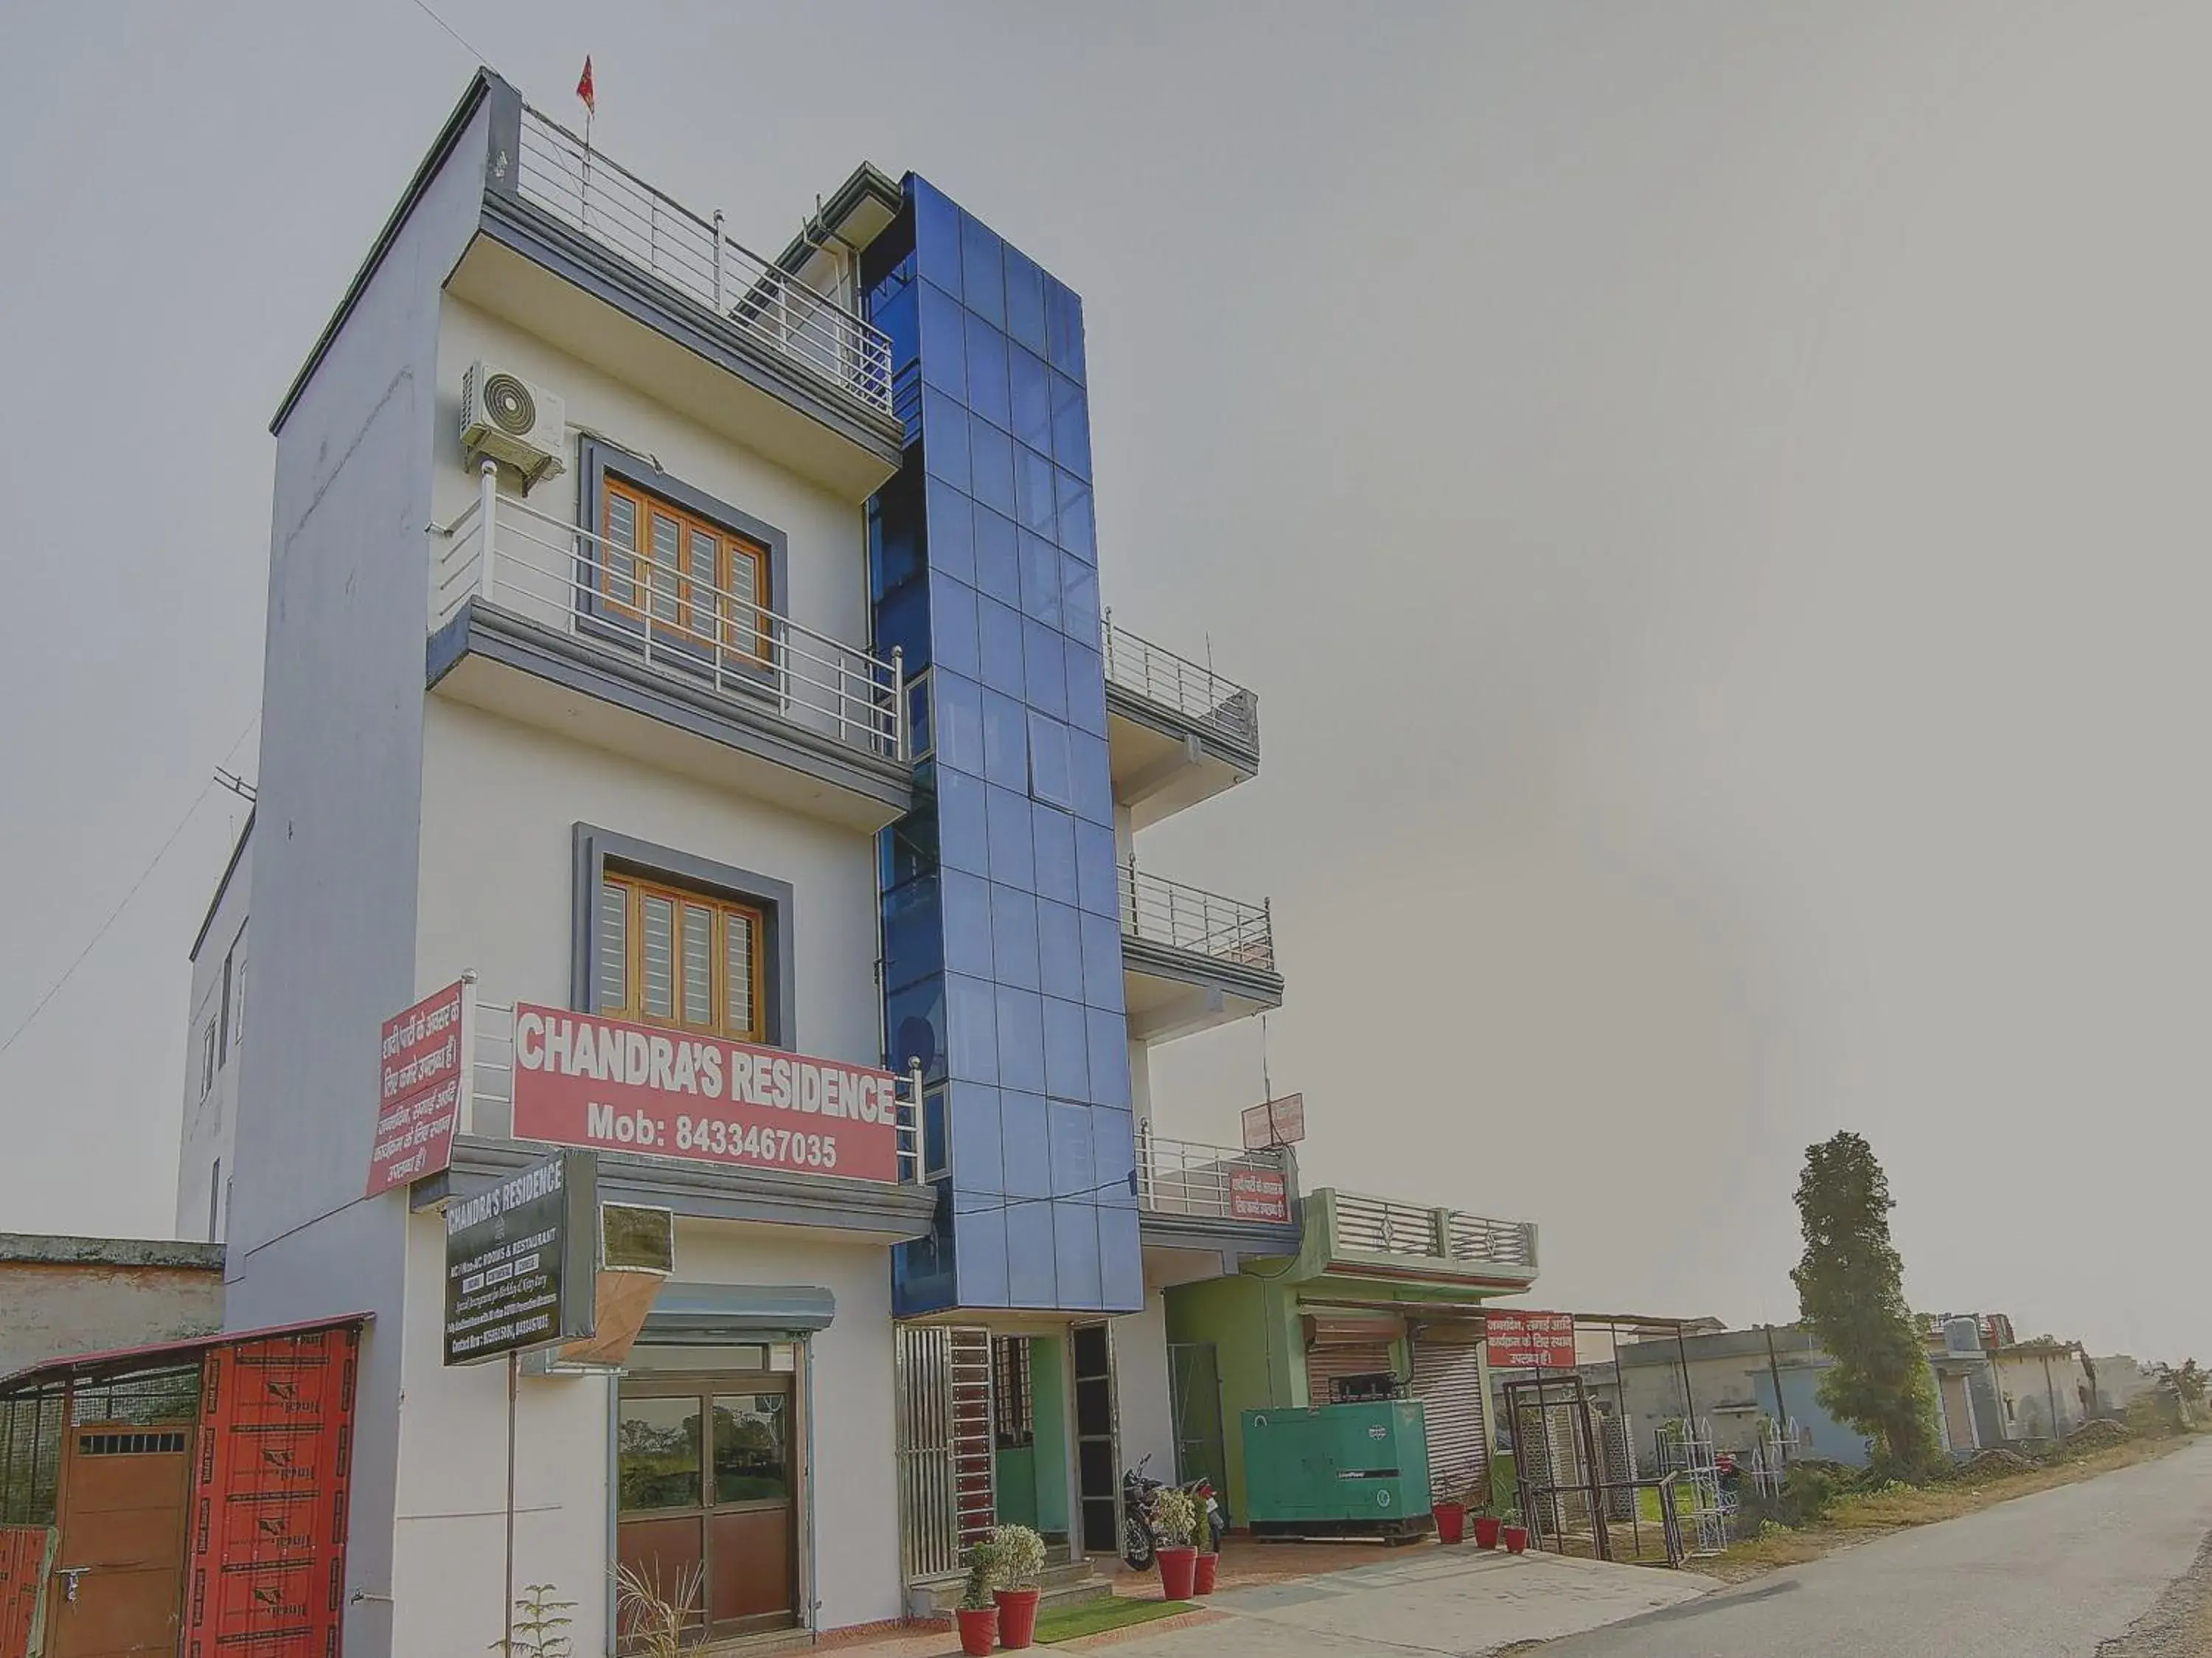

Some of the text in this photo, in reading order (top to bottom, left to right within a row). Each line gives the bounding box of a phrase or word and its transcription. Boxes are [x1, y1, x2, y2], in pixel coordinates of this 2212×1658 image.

[516, 1013, 896, 1126] CHANDRA'S RESIDENCE
[588, 1102, 837, 1169] Mob: 8433467035
[502, 1159, 563, 1213] RESIDENCE
[512, 1227, 557, 1255] RESTAURANT
